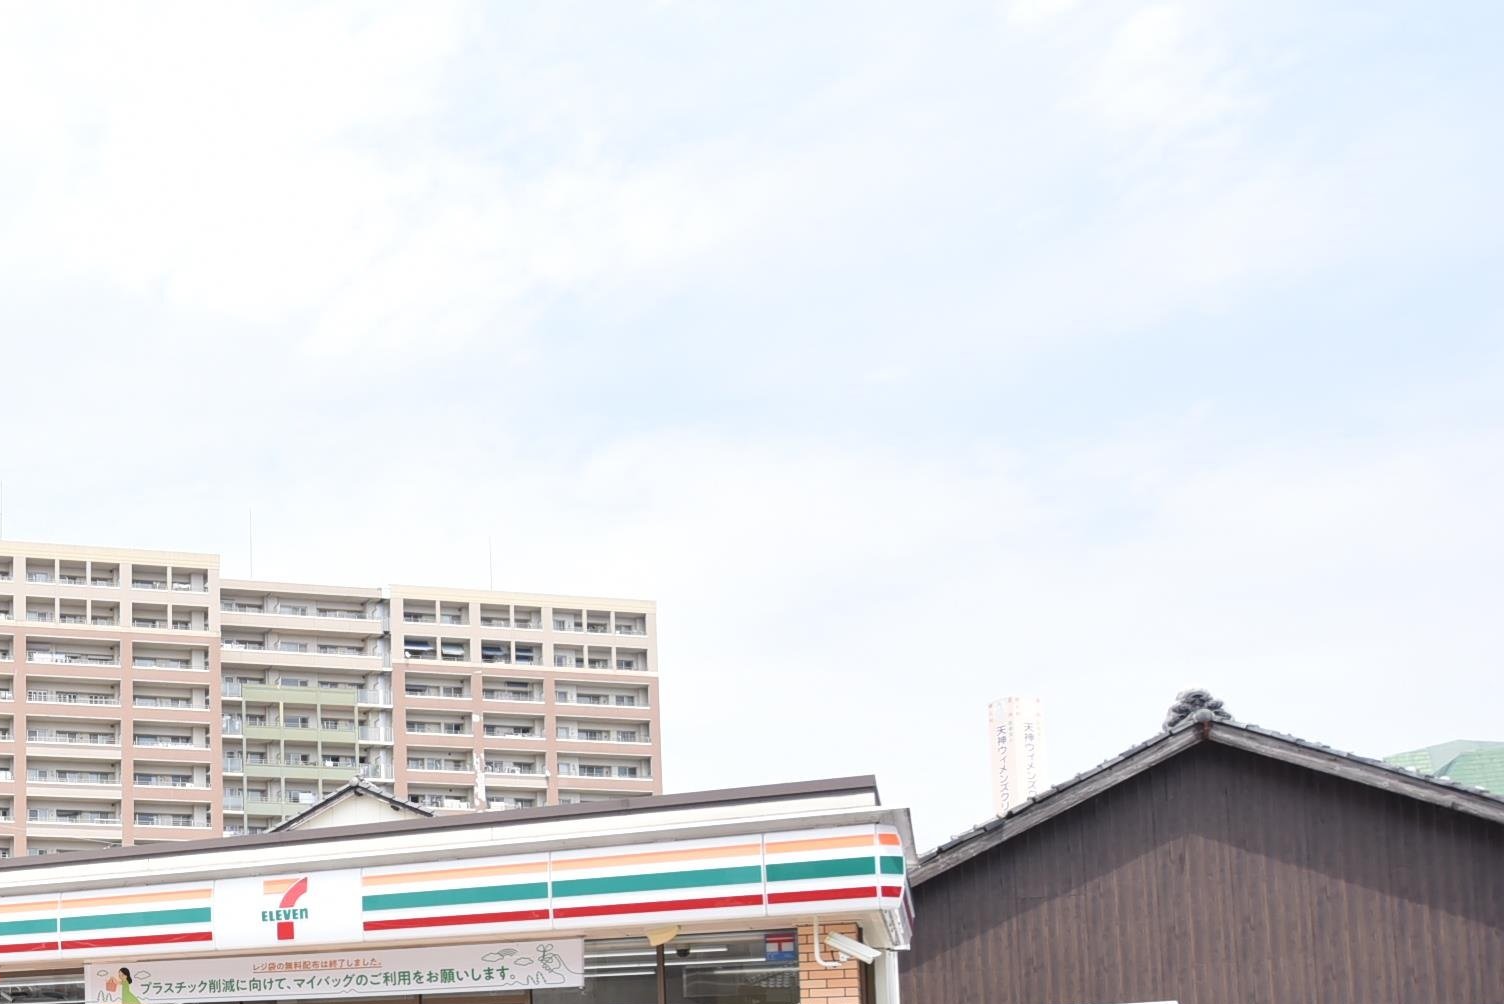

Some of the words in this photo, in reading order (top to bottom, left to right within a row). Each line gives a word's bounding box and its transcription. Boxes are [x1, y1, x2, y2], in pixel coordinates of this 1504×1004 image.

[262, 876, 308, 940] 7
[252, 957, 383, 971] レジ袋の無料配布は終了しました。
[140, 965, 516, 995] プラスチック削減に向けて、マイバッグのご利用をお願いします。
